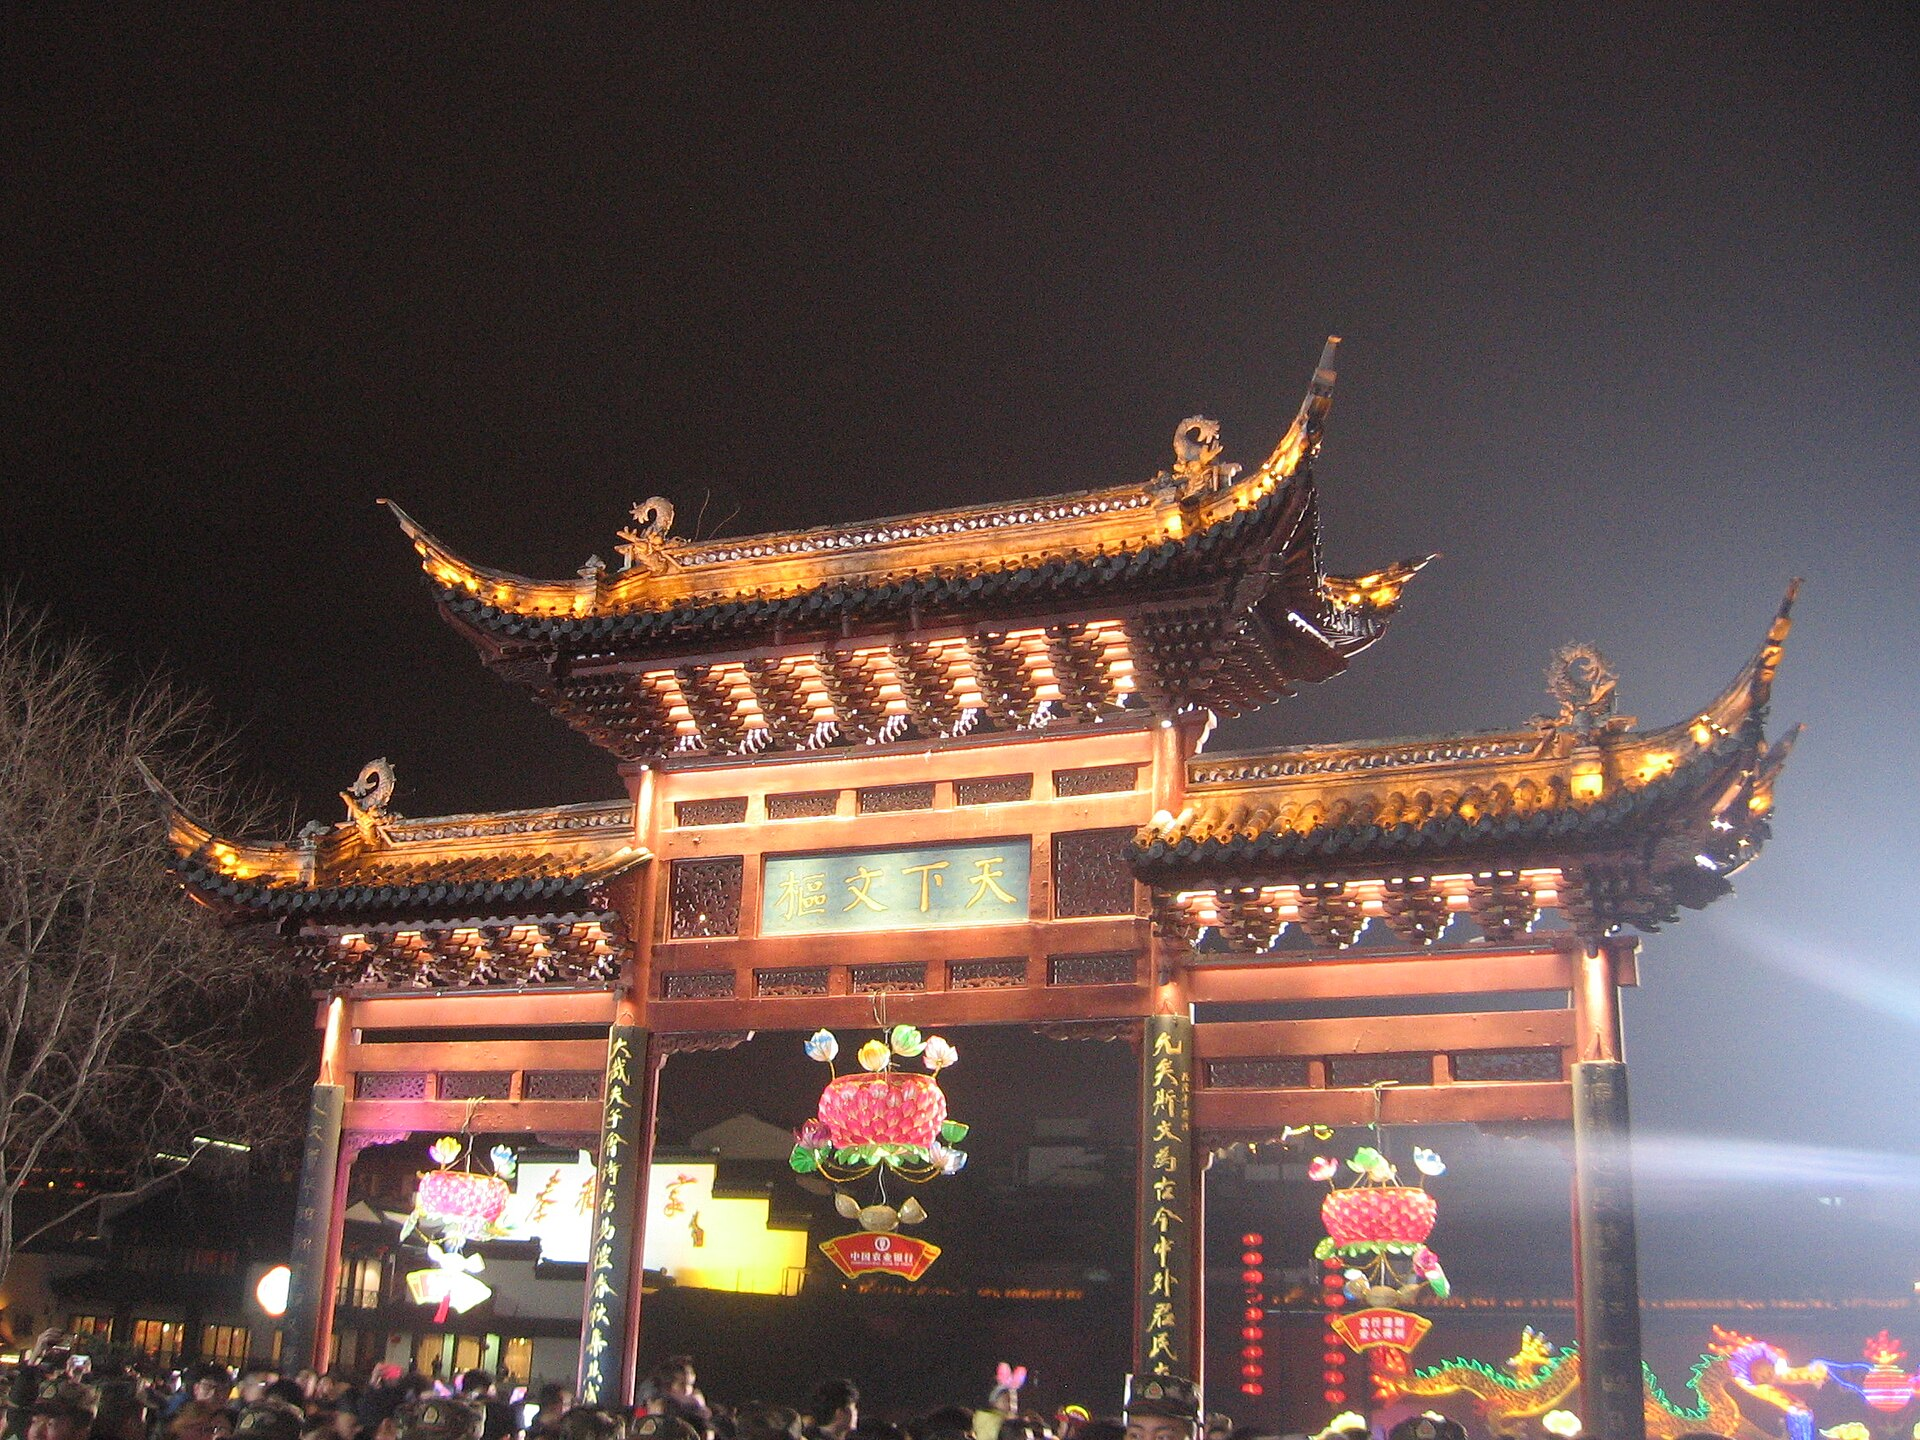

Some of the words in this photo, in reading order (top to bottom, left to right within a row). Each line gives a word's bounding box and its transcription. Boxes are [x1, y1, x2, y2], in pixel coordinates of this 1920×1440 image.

[775, 857, 1018, 921] 天下文樞
[850, 1251, 914, 1262] 中国农业银行
